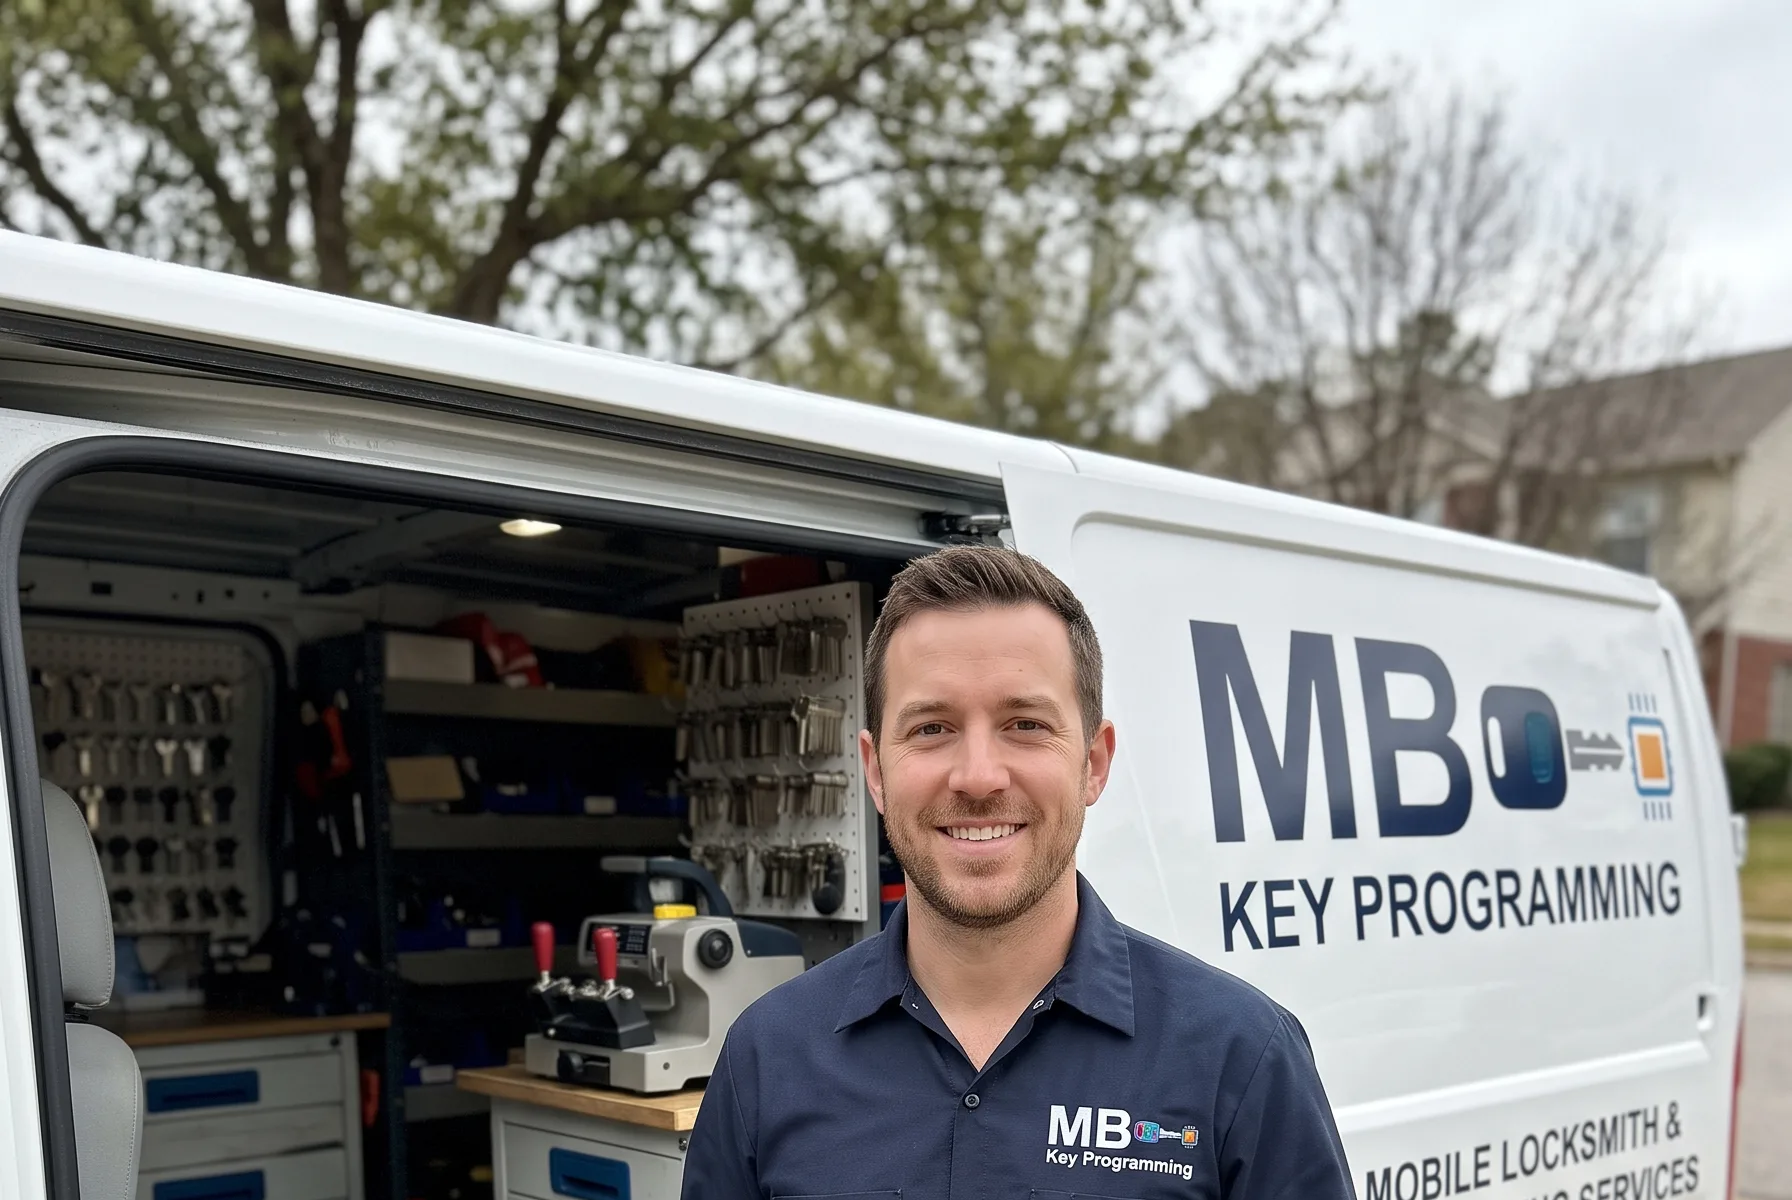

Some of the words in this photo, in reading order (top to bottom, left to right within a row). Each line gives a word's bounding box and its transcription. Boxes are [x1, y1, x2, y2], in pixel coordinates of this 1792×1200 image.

[1189, 620, 1473, 843] MB
[1219, 877, 1334, 952] KEY
[1352, 862, 1681, 941] PROGRAMMING
[1046, 1149, 1078, 1168] Key
[1082, 1151, 1193, 1180] Programming
[1047, 1104, 1132, 1149] MB
[1502, 1106, 1659, 1182] LOCKSMITH
[1666, 1101, 1681, 1139] &
